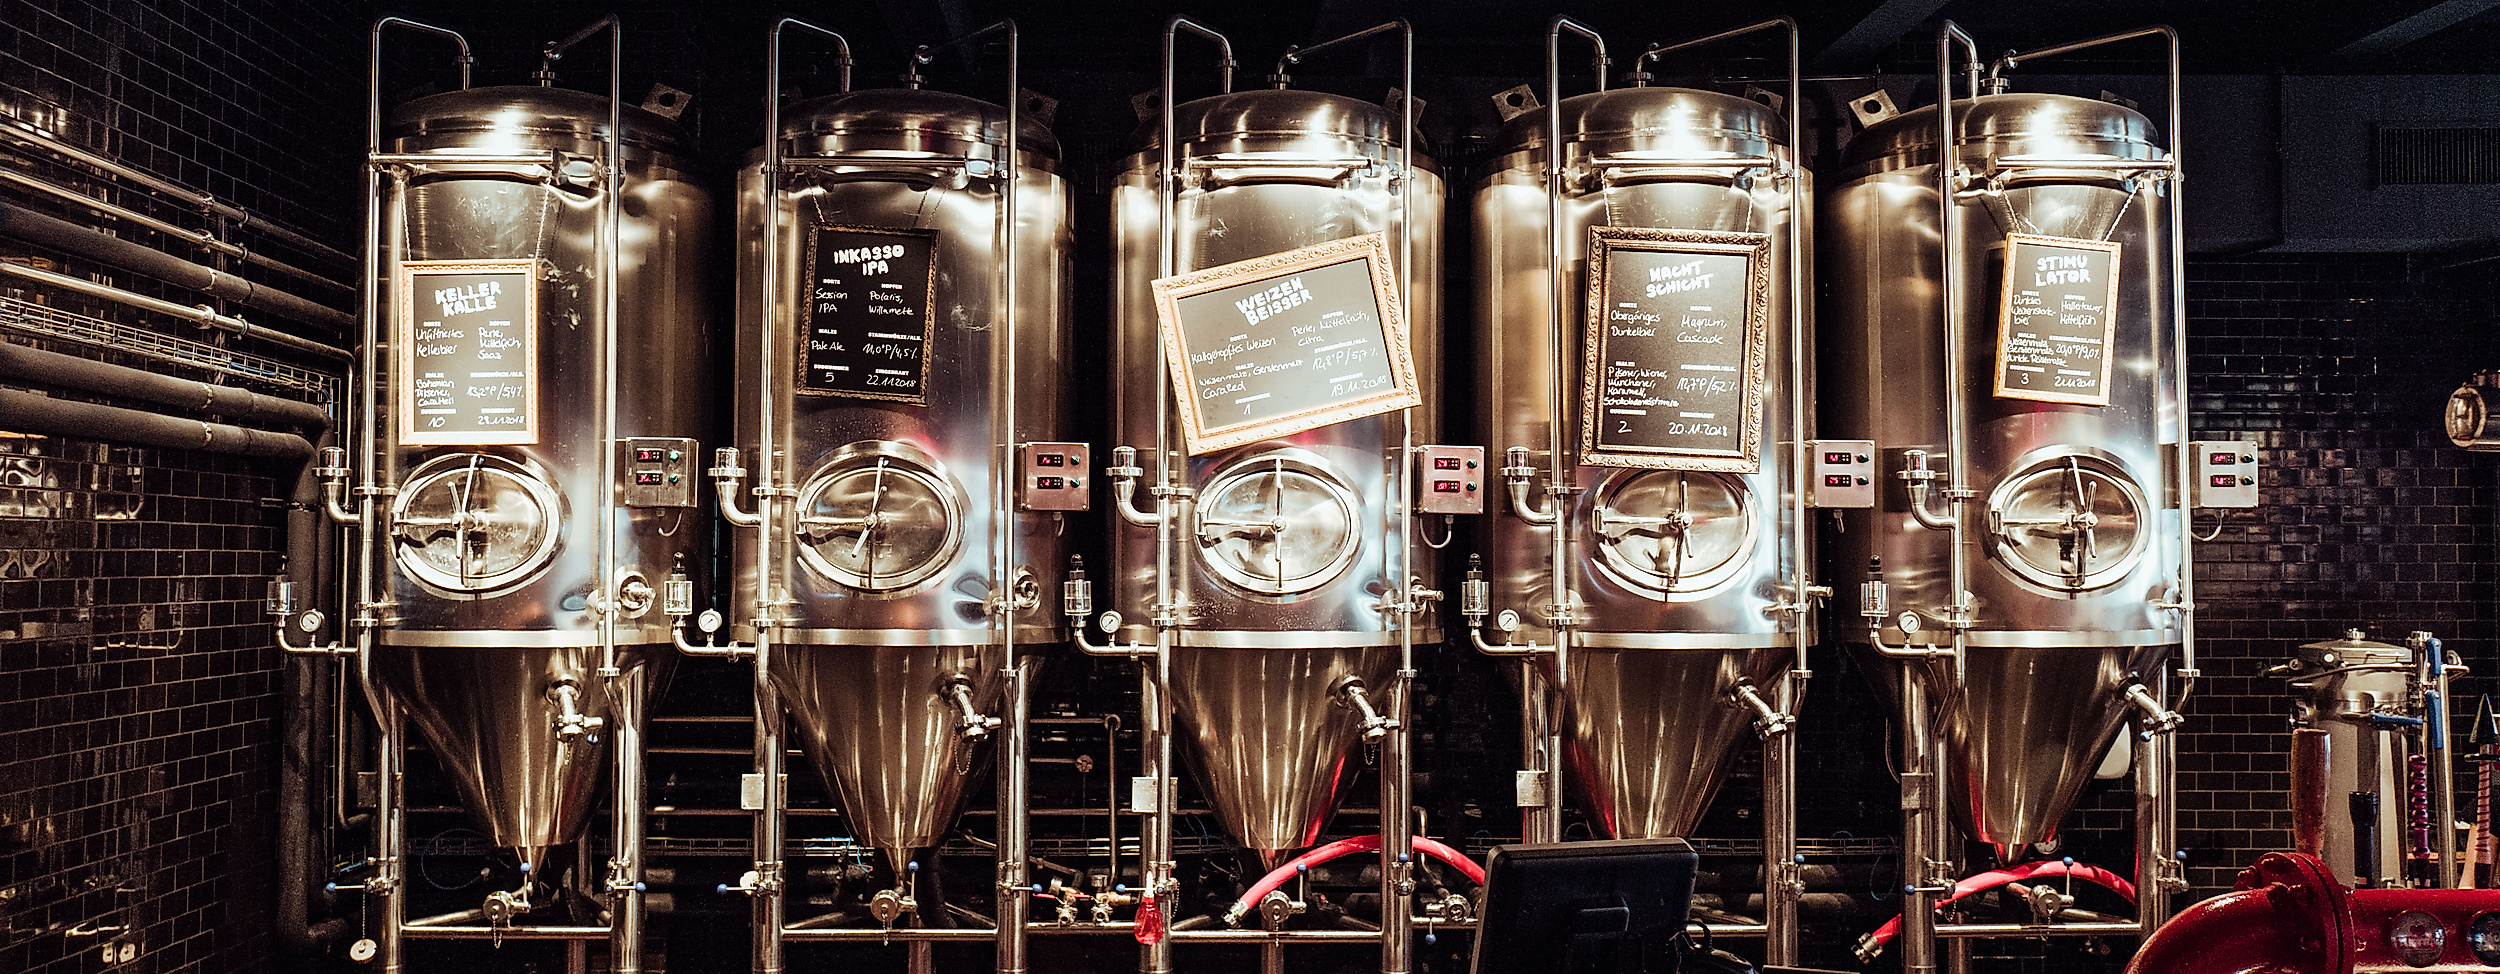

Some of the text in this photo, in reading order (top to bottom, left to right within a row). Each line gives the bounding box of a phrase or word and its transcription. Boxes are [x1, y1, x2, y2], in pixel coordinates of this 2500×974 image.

[834, 244, 905, 264] INKASSO
[862, 260, 889, 276] IPA
[2037, 255, 2088, 271] STIMU
[1649, 260, 1705, 282] NACHT
[2035, 269, 2091, 287] LATOR
[435, 281, 501, 304] KELLER
[1646, 273, 1714, 299] SCHICHT
[815, 287, 848, 300] Session
[869, 290, 904, 304] Polaris,
[1235, 276, 1304, 314] WEIZEN
[443, 295, 497, 317] KALLE
[818, 303, 838, 314] IPA
[868, 304, 914, 316] Willamette
[1245, 289, 1313, 326] BEISSER
[1291, 324, 1316, 336] Perle,
[1681, 314, 1727, 332] Magnum,
[811, 340, 846, 351] Pale Ale
[1246, 337, 1277, 351] Weizen
[1297, 336, 1324, 347] Citra
[1676, 332, 1724, 345] Cascade
[825, 372, 835, 383] 5
[2020, 373, 2029, 384] 3
[1243, 403, 1251, 415] 1
[428, 416, 446, 428] 10
[1617, 420, 1632, 433] 2
